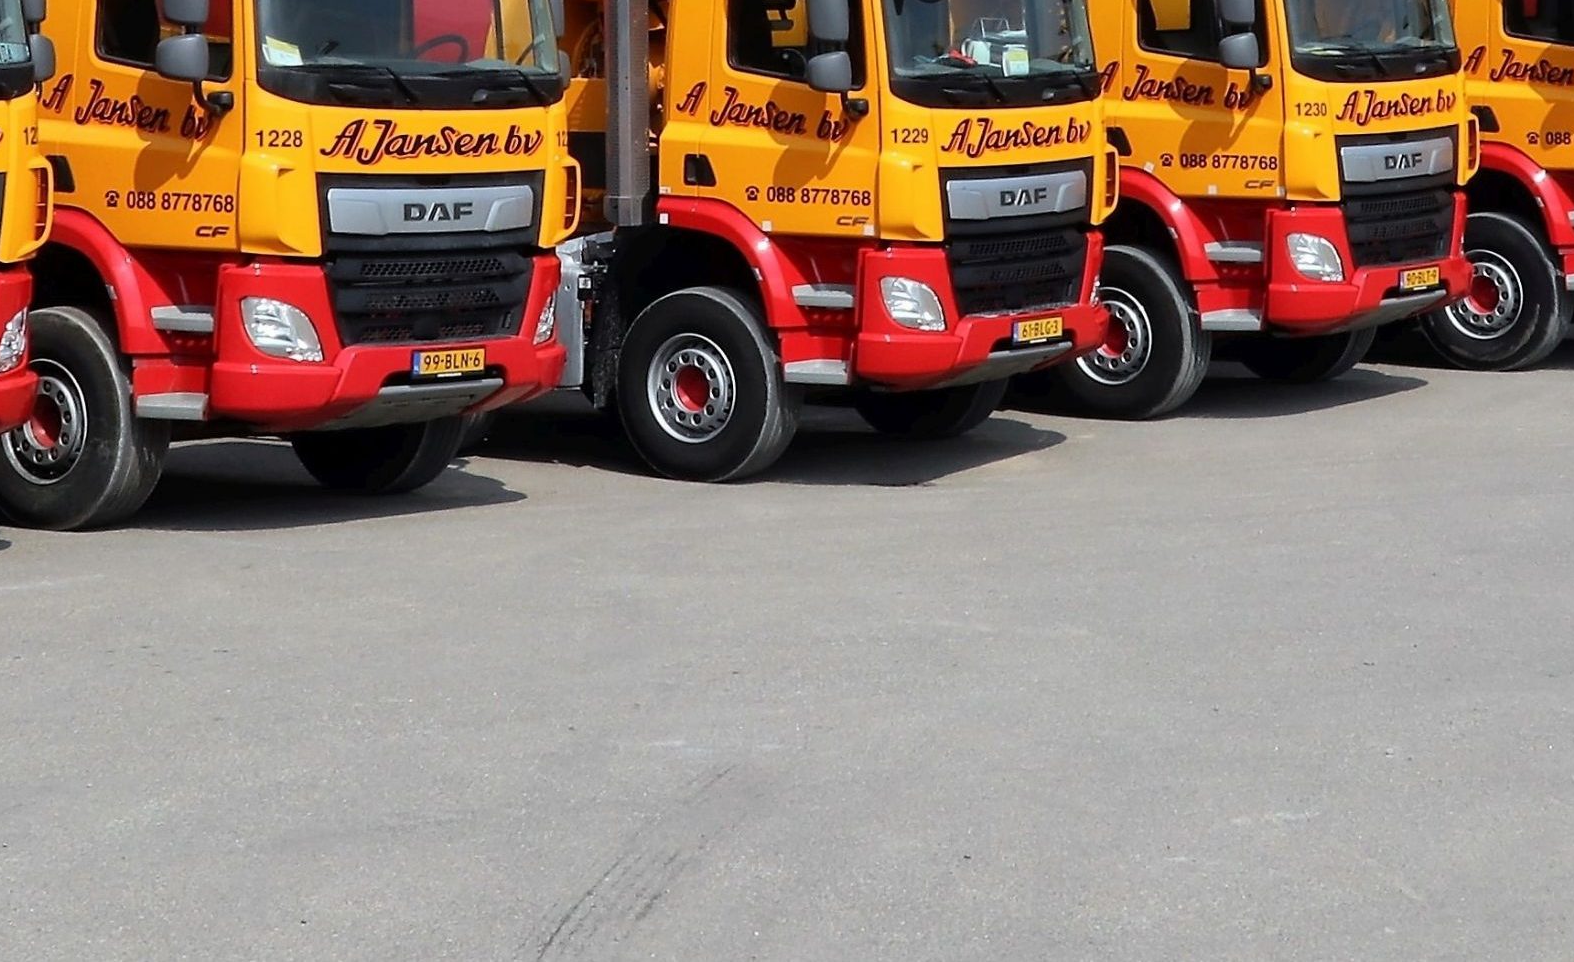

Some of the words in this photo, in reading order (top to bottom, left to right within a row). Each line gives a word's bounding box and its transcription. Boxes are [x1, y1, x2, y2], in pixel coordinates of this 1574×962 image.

[1464, 46, 1487, 74] A
[1099, 61, 1120, 93] A
[1123, 64, 1214, 105] Jansen
[42, 74, 74, 113] A
[75, 79, 171, 133] Jansen
[676, 82, 707, 117] A
[710, 86, 806, 135] Jansen
[817, 110, 848, 142] bv
[1295, 102, 1327, 116] 1230
[1356, 90, 1433, 126] Jansen
[1436, 89, 1457, 113] bv
[255, 129, 303, 148] 1228
[356, 119, 501, 165] Jansen
[503, 124, 544, 156] bv
[891, 128, 928, 144] 1229
[966, 118, 1063, 158] Jansen
[1067, 117, 1092, 144] bv
[1546, 131, 1571, 145] 088
[1180, 153, 1207, 169] 088
[1212, 154, 1278, 170] 8778768
[1384, 153, 1422, 170] DAF
[127, 191, 155, 209] 088
[161, 192, 234, 213] 8778768
[767, 186, 795, 203] 088
[800, 188, 871, 206] 8778768
[1000, 188, 1047, 207] DAF
[403, 202, 473, 221] DAF
[836, 216, 869, 226] CF
[195, 226, 229, 237] CF
[424, 352, 480, 370] 99-BLN-6
